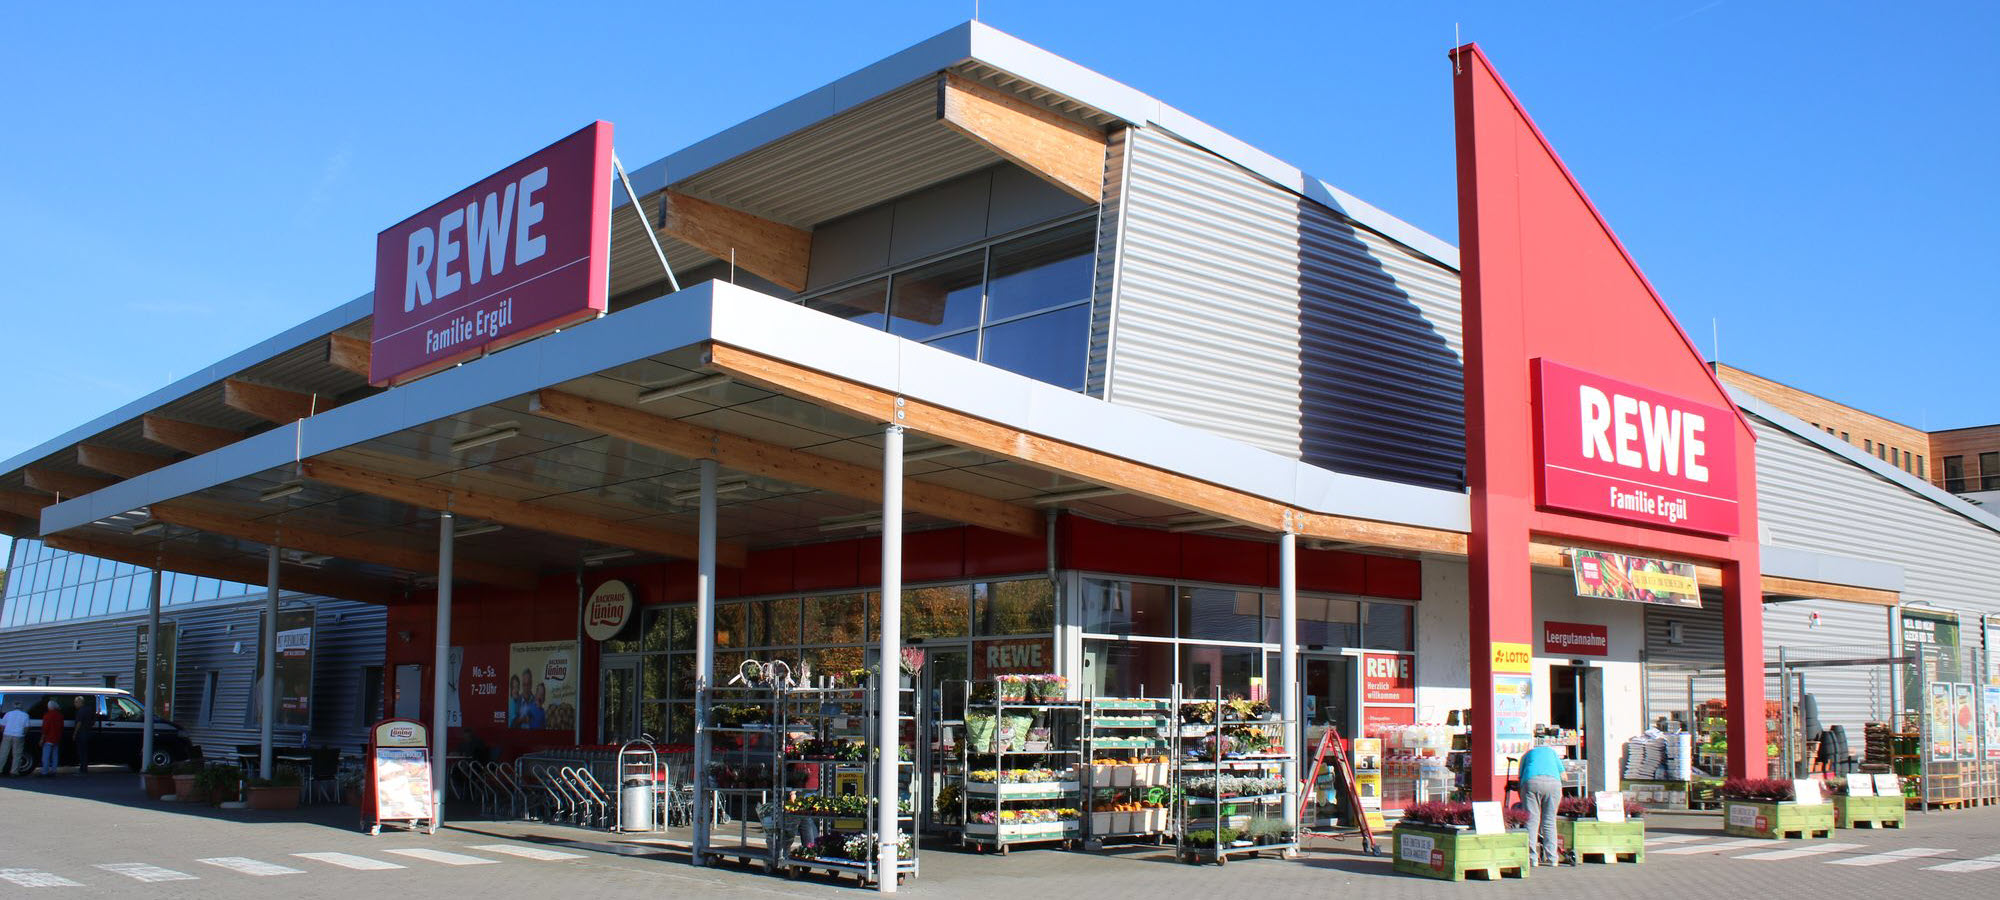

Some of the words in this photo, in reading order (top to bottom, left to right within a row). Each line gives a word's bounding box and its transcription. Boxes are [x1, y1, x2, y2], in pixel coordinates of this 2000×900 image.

[404, 166, 549, 313] REWE
[426, 315, 473, 355] Familie
[476, 297, 512, 338] Ergül
[1579, 384, 1709, 483] REWE
[1610, 486, 1655, 515] Familie
[1657, 495, 1687, 523] Ergül
[595, 592, 625, 603] BACKHAUS
[590, 602, 624, 626] Lüning
[1546, 630, 1606, 647] Leergutannahme
[986, 644, 1042, 668] REWE
[1505, 651, 1529, 663] LOTTO
[544, 664, 567, 681] Lüning
[1367, 657, 1409, 679] REWE
[1367, 681, 1390, 690] Herzlich
[1367, 690, 1400, 700] willkommen
